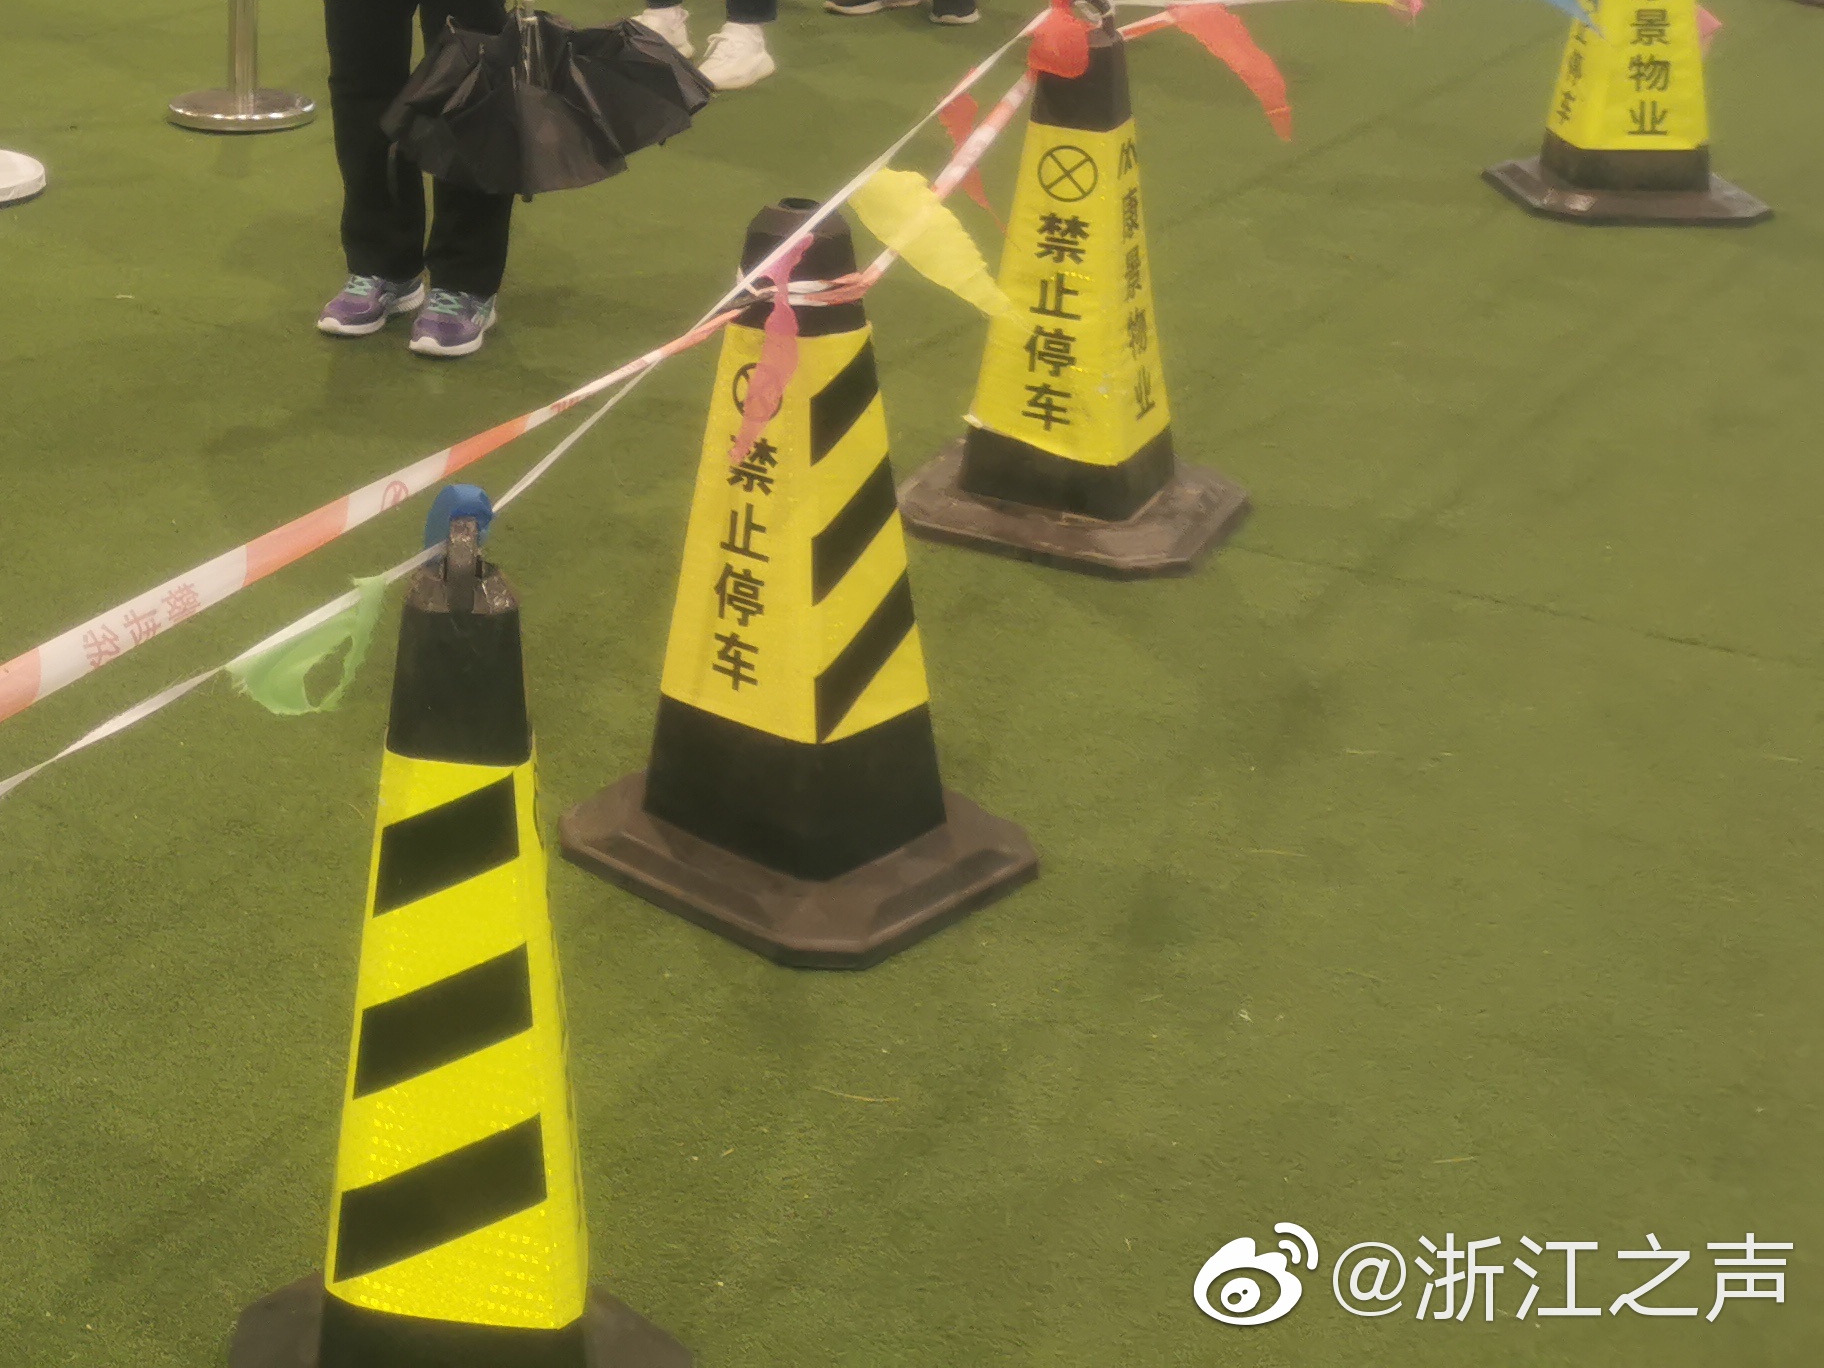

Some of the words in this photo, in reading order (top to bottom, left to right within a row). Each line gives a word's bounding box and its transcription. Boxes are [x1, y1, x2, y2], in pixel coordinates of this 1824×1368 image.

[1021, 212, 1090, 431] 禁止停车
[1121, 186, 1156, 421] 康景物业
[712, 436, 778, 692] 禁止停车
